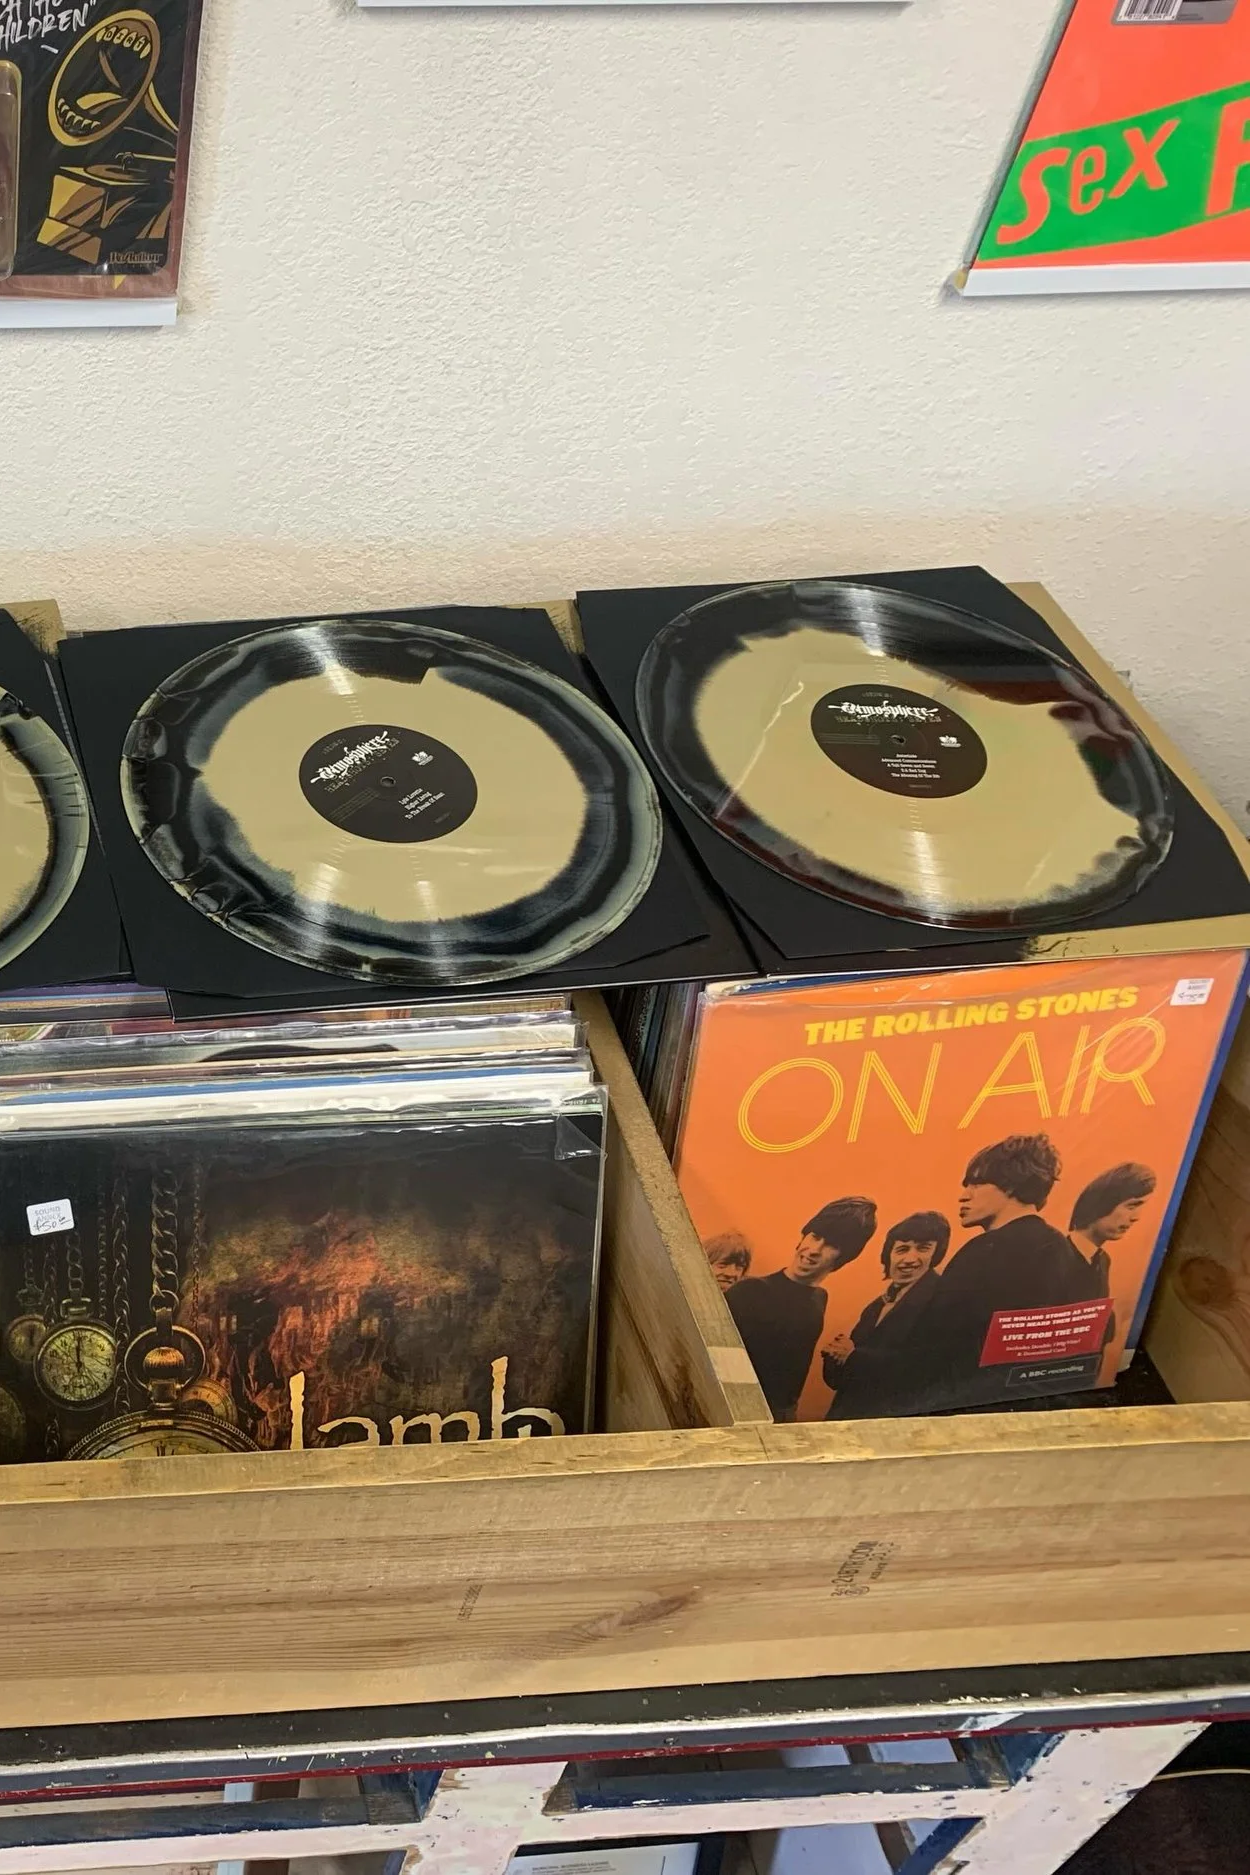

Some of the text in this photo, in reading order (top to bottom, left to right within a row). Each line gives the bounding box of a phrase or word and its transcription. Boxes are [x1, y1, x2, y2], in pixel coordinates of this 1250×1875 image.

[996, 117, 1181, 245] Sex
[804, 985, 1140, 1046] THE ROLLING STONES
[738, 1016, 1167, 1154] ON AIR
[1002, 1325, 1091, 1342] LIVE FROM THE BBC
[1028, 1369, 1047, 1377] BBC
